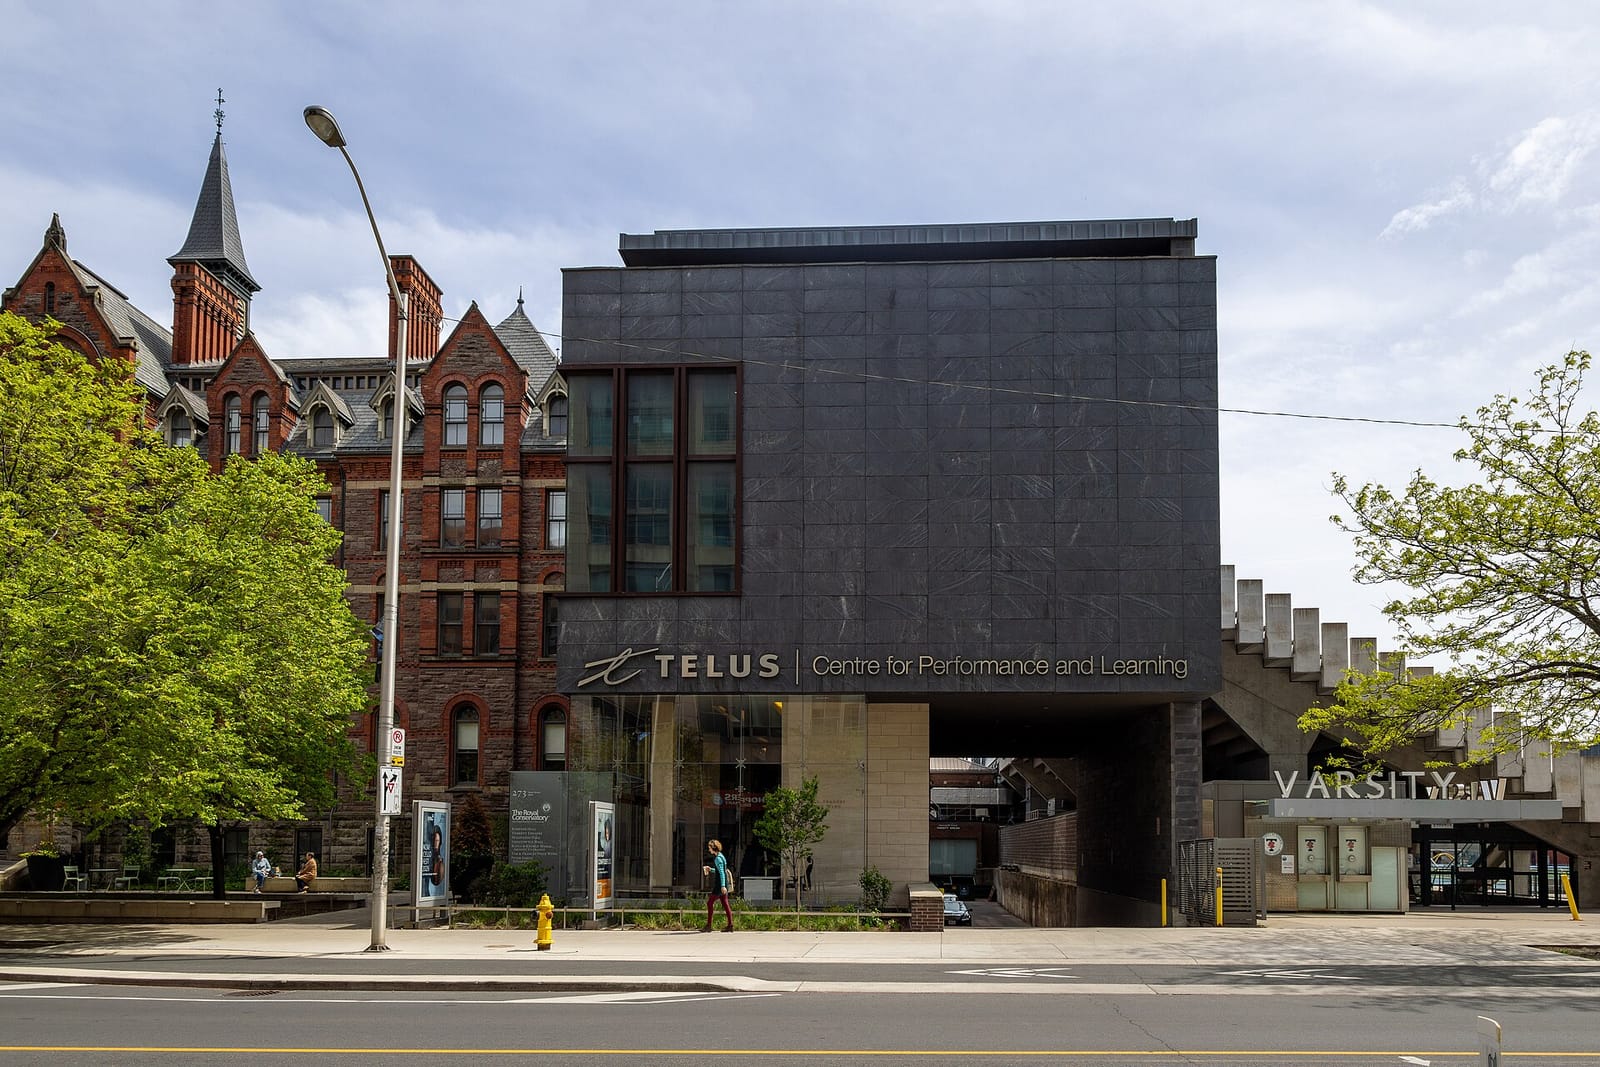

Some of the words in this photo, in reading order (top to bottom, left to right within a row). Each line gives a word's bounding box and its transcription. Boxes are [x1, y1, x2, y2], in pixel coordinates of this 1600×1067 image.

[655, 653, 780, 678] TELUS
[812, 655, 880, 676] Centre
[886, 655, 913, 675] for
[919, 655, 1049, 676] Performance
[1055, 655, 1094, 676] and
[1101, 655, 1188, 679] Learning
[512, 790, 527, 798] 273
[1273, 770, 1456, 800] VARSITY
[523, 809, 539, 817] Royal
